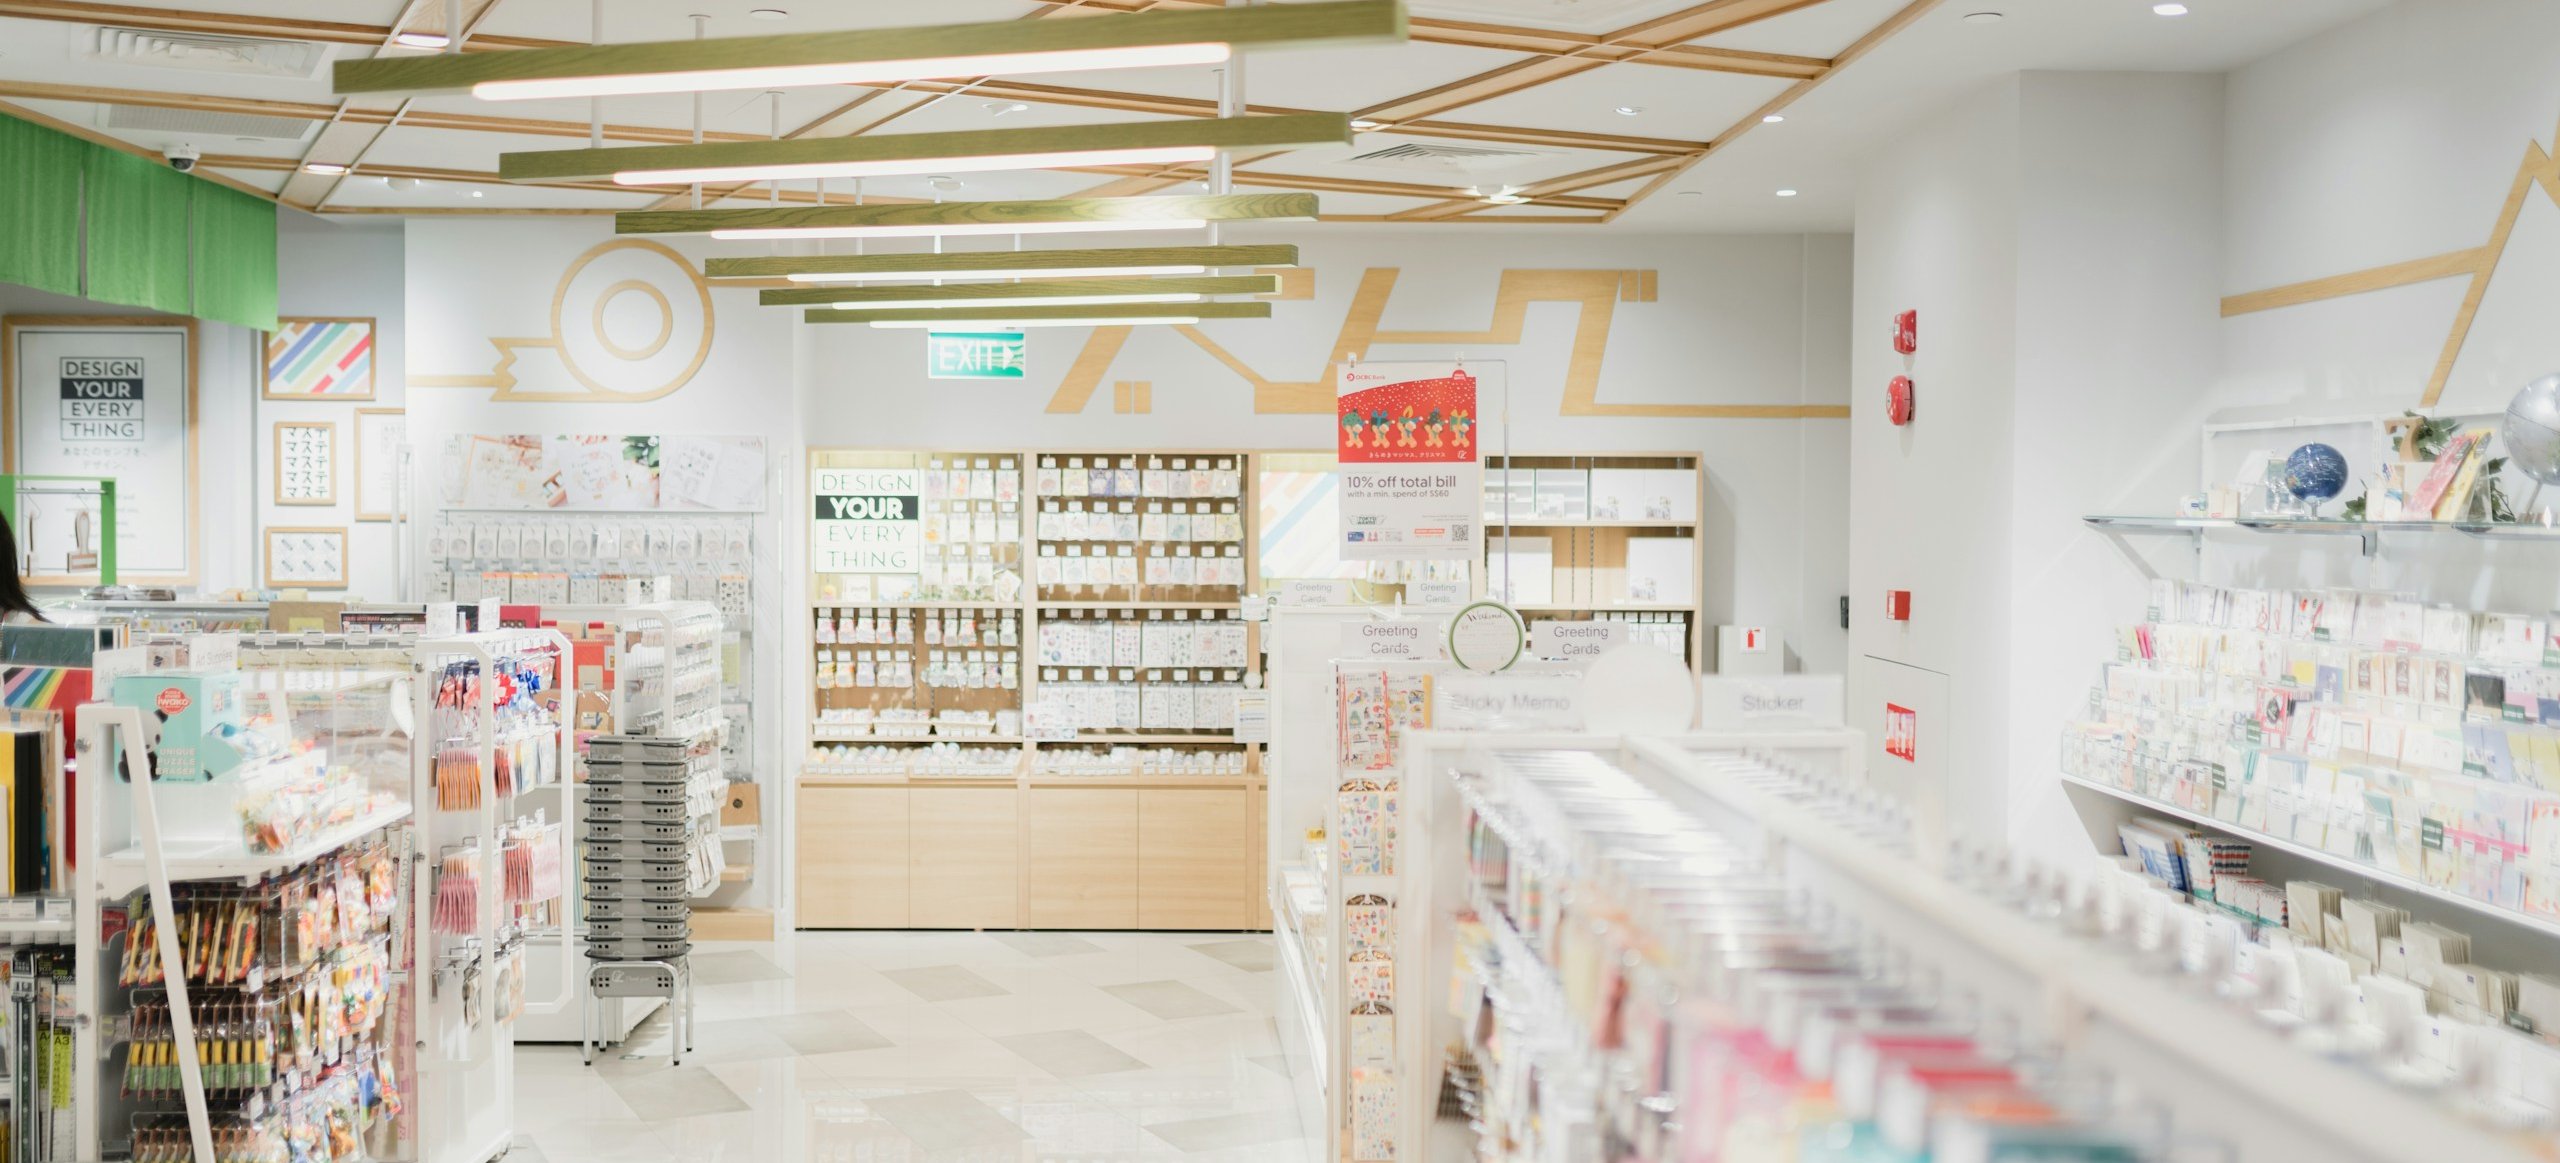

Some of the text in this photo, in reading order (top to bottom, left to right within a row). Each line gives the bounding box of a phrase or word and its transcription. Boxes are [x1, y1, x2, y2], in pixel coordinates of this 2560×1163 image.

[939, 340, 998, 371] EXIT
[65, 361, 138, 376] DESIGN
[73, 380, 131, 398] YOUR
[72, 402, 134, 417] EVERY
[69, 422, 134, 437] THING
[822, 474, 912, 491] DESIGN
[1347, 475, 1456, 488] 10% off total bill
[1347, 490, 1365, 498] with
[1374, 490, 1389, 498] min.
[1392, 490, 1417, 499] spend
[1419, 490, 1428, 498] of
[829, 497, 904, 519] YOUR
[829, 525, 906, 541] EVERY
[826, 551, 906, 568] THING
[1295, 583, 1332, 592] Greeting
[1420, 583, 1457, 593] Greeting
[1425, 595, 1451, 603] Cards
[1362, 625, 1418, 639] Greeting
[1553, 626, 1609, 640] Greeting
[1371, 642, 1409, 654] Cards
[1562, 643, 1600, 655] Cards
[1451, 693, 1570, 714] Sticky Memo
[1742, 693, 1804, 712] Sticker
[160, 747, 195, 756] UNIQUE
[54, 1036, 70, 1045] A3
